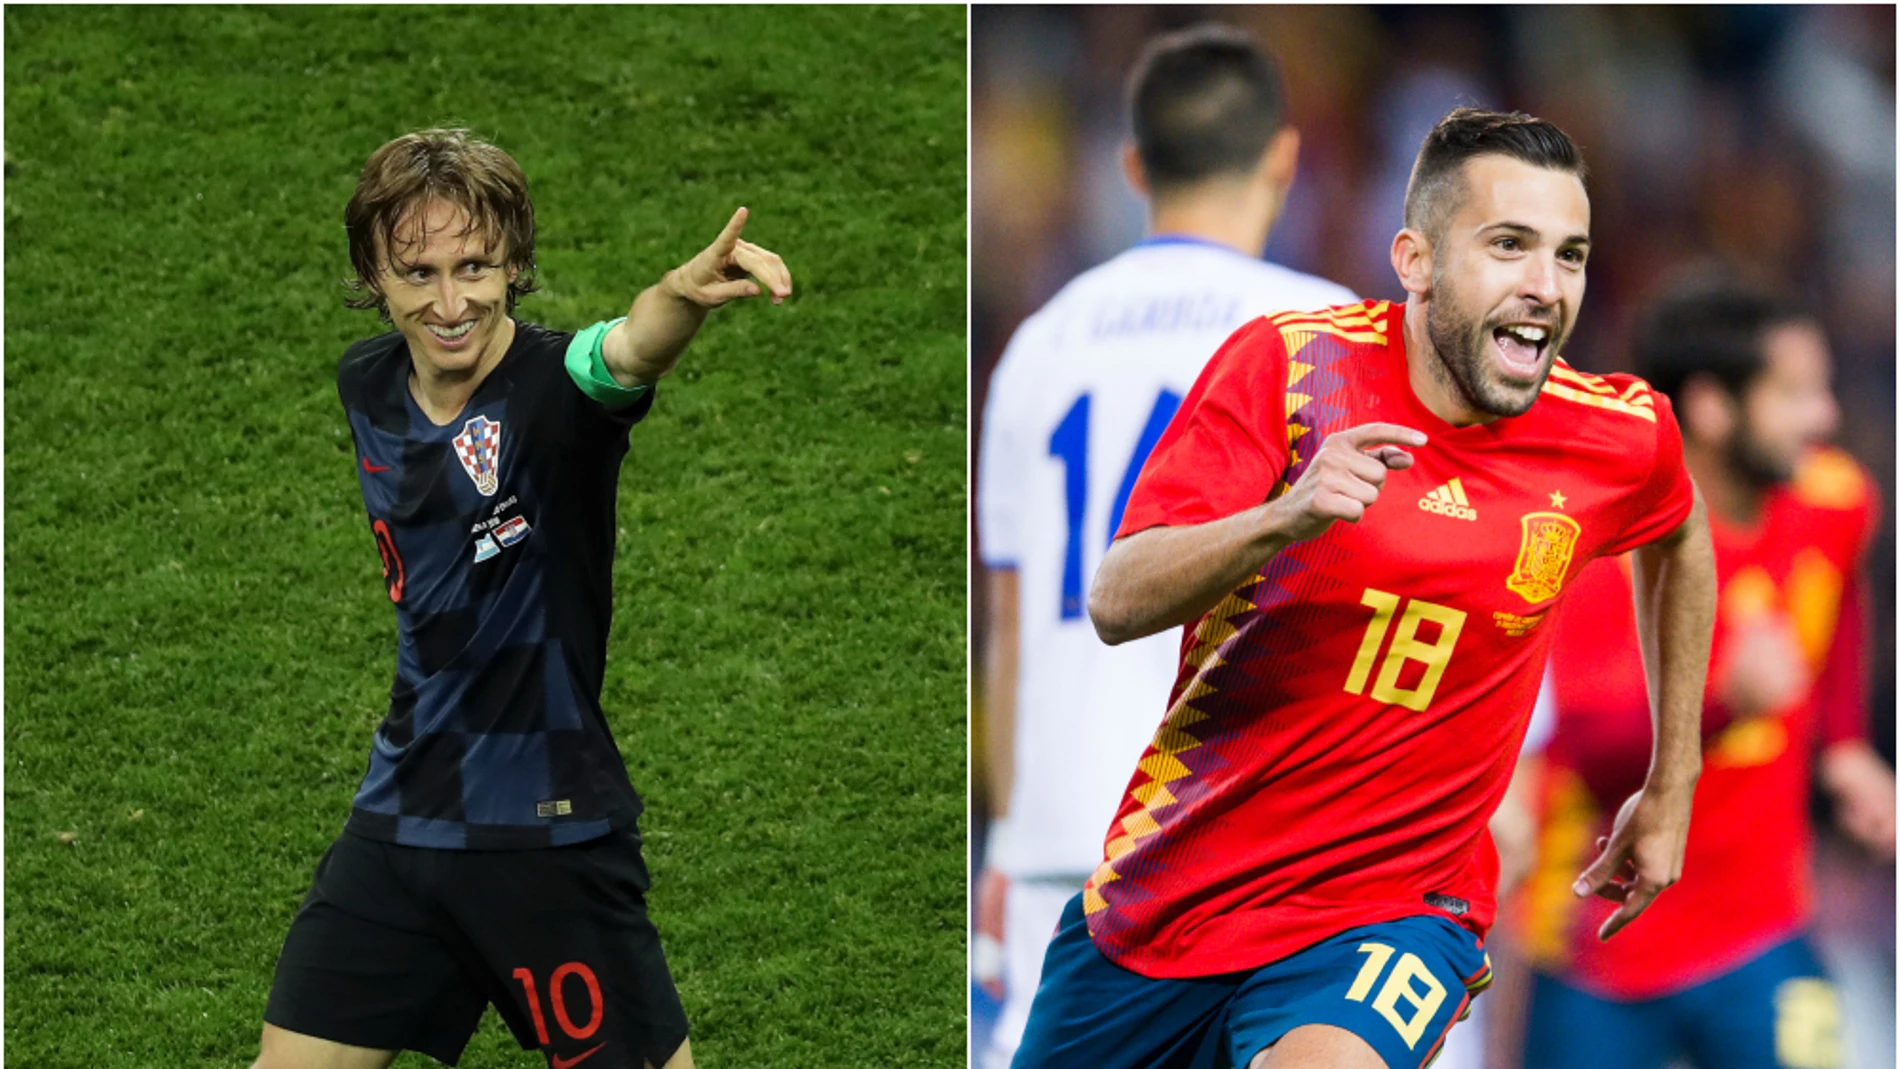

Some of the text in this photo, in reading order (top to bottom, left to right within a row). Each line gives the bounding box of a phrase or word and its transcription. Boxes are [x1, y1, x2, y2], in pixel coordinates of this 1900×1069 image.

[1418, 497, 1477, 521] adidas
[1343, 587, 1468, 713] 18
[512, 961, 604, 1045] 10
[1344, 942, 1448, 1051] 18
